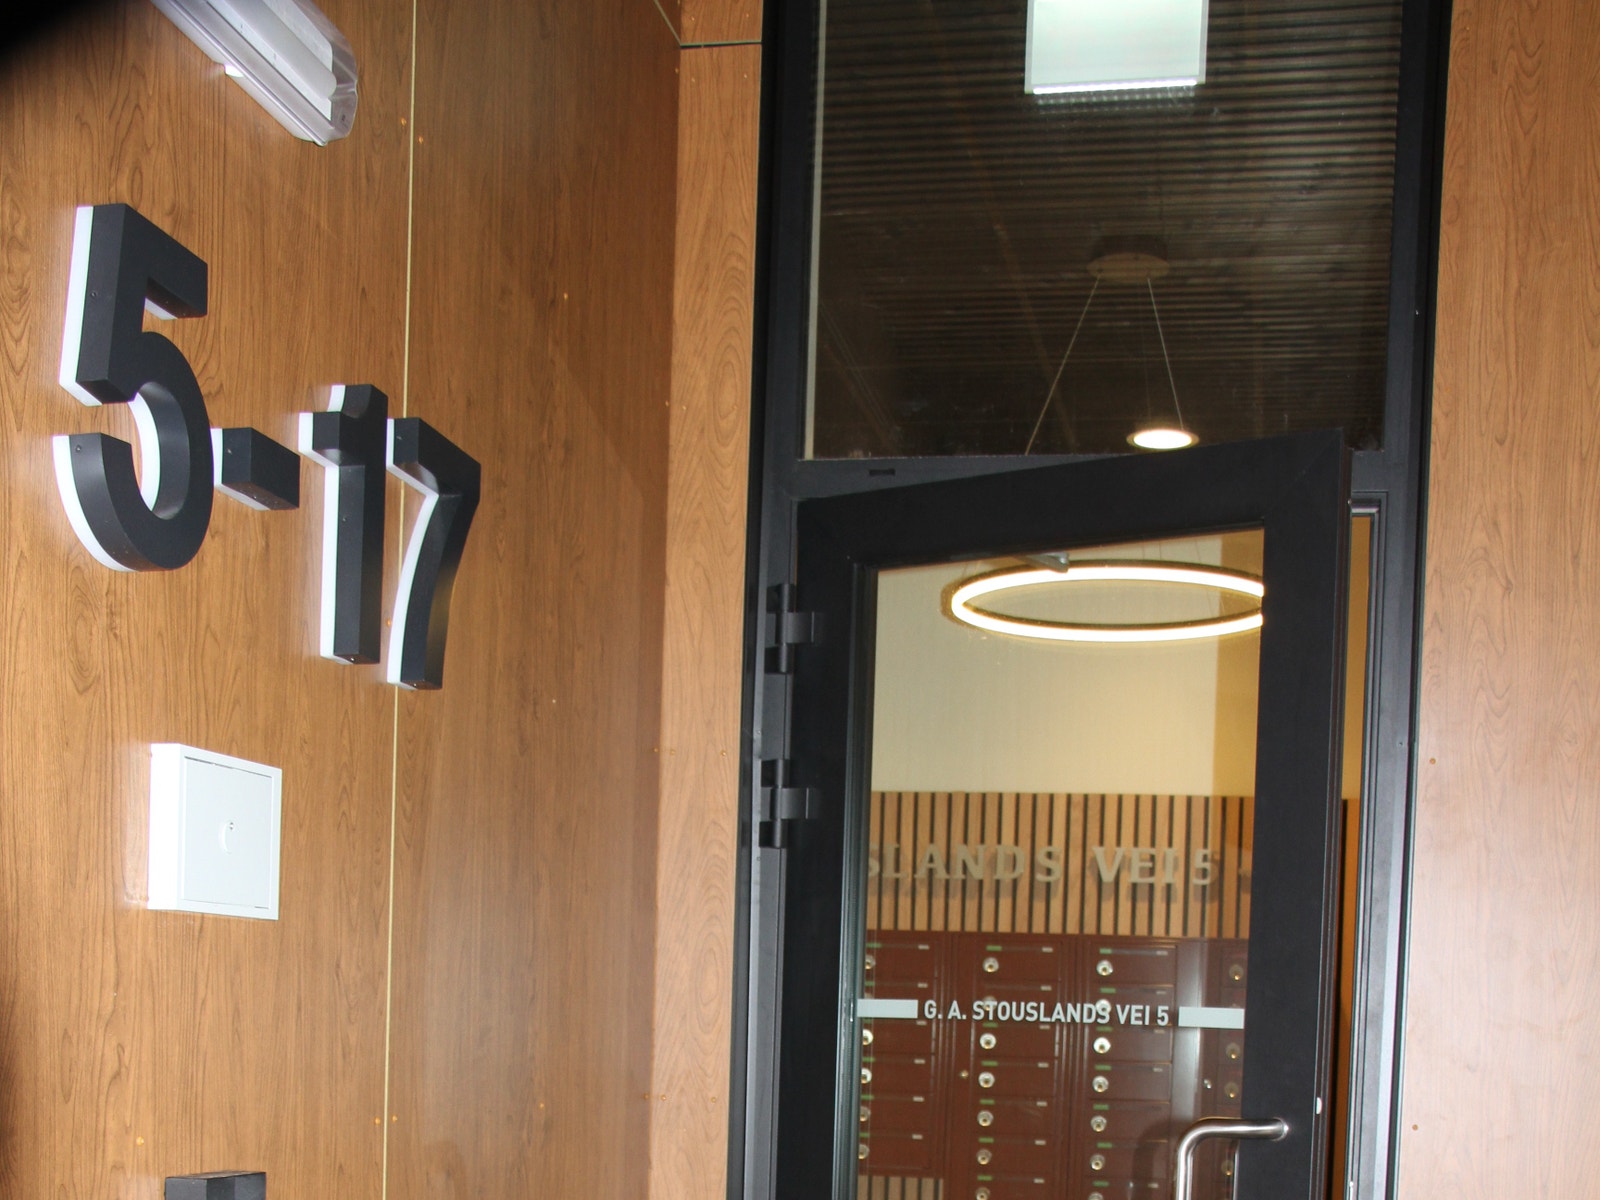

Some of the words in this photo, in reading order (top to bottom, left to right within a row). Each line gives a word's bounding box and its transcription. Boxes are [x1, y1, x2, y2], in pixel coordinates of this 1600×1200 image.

[52, 202, 482, 690] 5-17
[1091, 846, 1178, 884] VEI
[1192, 848, 1219, 886] 5
[923, 999, 943, 1020] G.
[947, 999, 967, 1020] A.
[972, 1000, 1111, 1025] STOUSLANDS
[1115, 1003, 1151, 1026] VEI
[1156, 1005, 1170, 1027] 5
